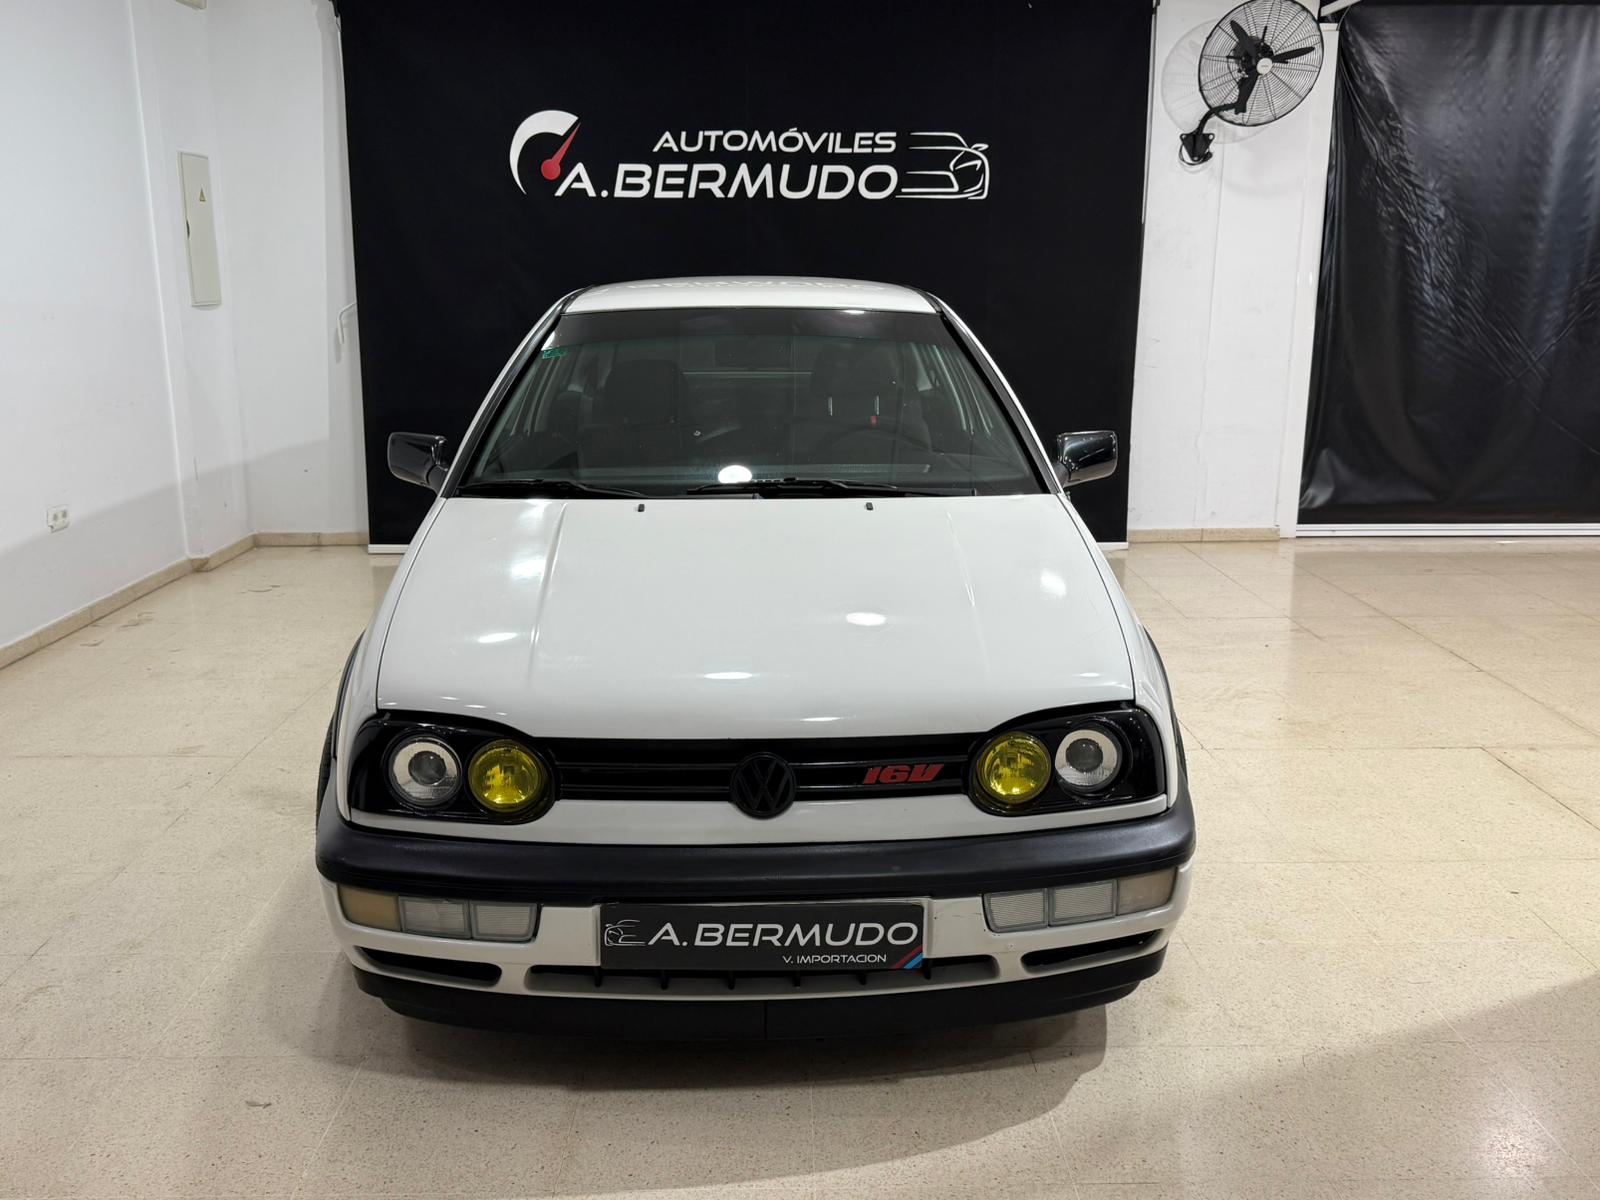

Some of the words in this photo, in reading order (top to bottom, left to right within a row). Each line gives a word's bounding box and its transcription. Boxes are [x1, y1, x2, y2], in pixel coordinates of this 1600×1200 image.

[652, 128, 897, 153] AUTOMÓVILES
[554, 162, 898, 199] A.BERMUDO
[862, 763, 945, 785] 16V
[648, 922, 919, 947] A.BERMUDO
[782, 955, 794, 964] V.
[796, 954, 887, 964] IMPORTACION
